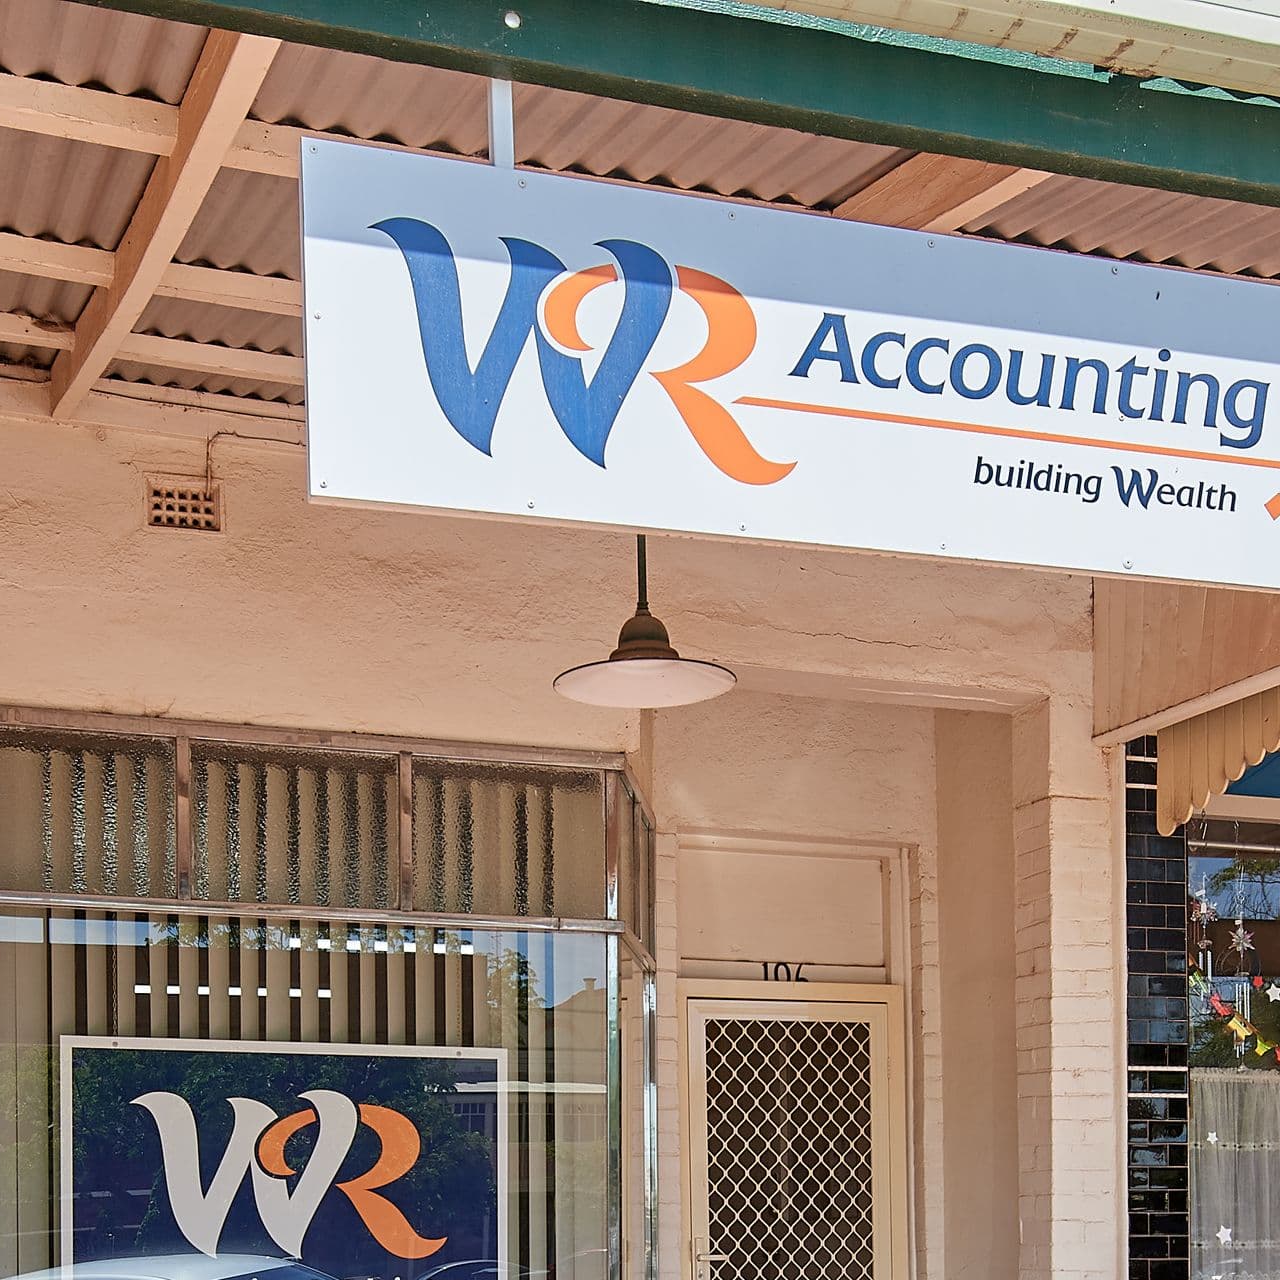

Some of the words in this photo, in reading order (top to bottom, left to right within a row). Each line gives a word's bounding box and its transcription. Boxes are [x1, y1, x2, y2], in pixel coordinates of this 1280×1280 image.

[788, 312, 1270, 449] Accounting
[973, 456, 1103, 504] building
[1110, 466, 1238, 512] Wealth
